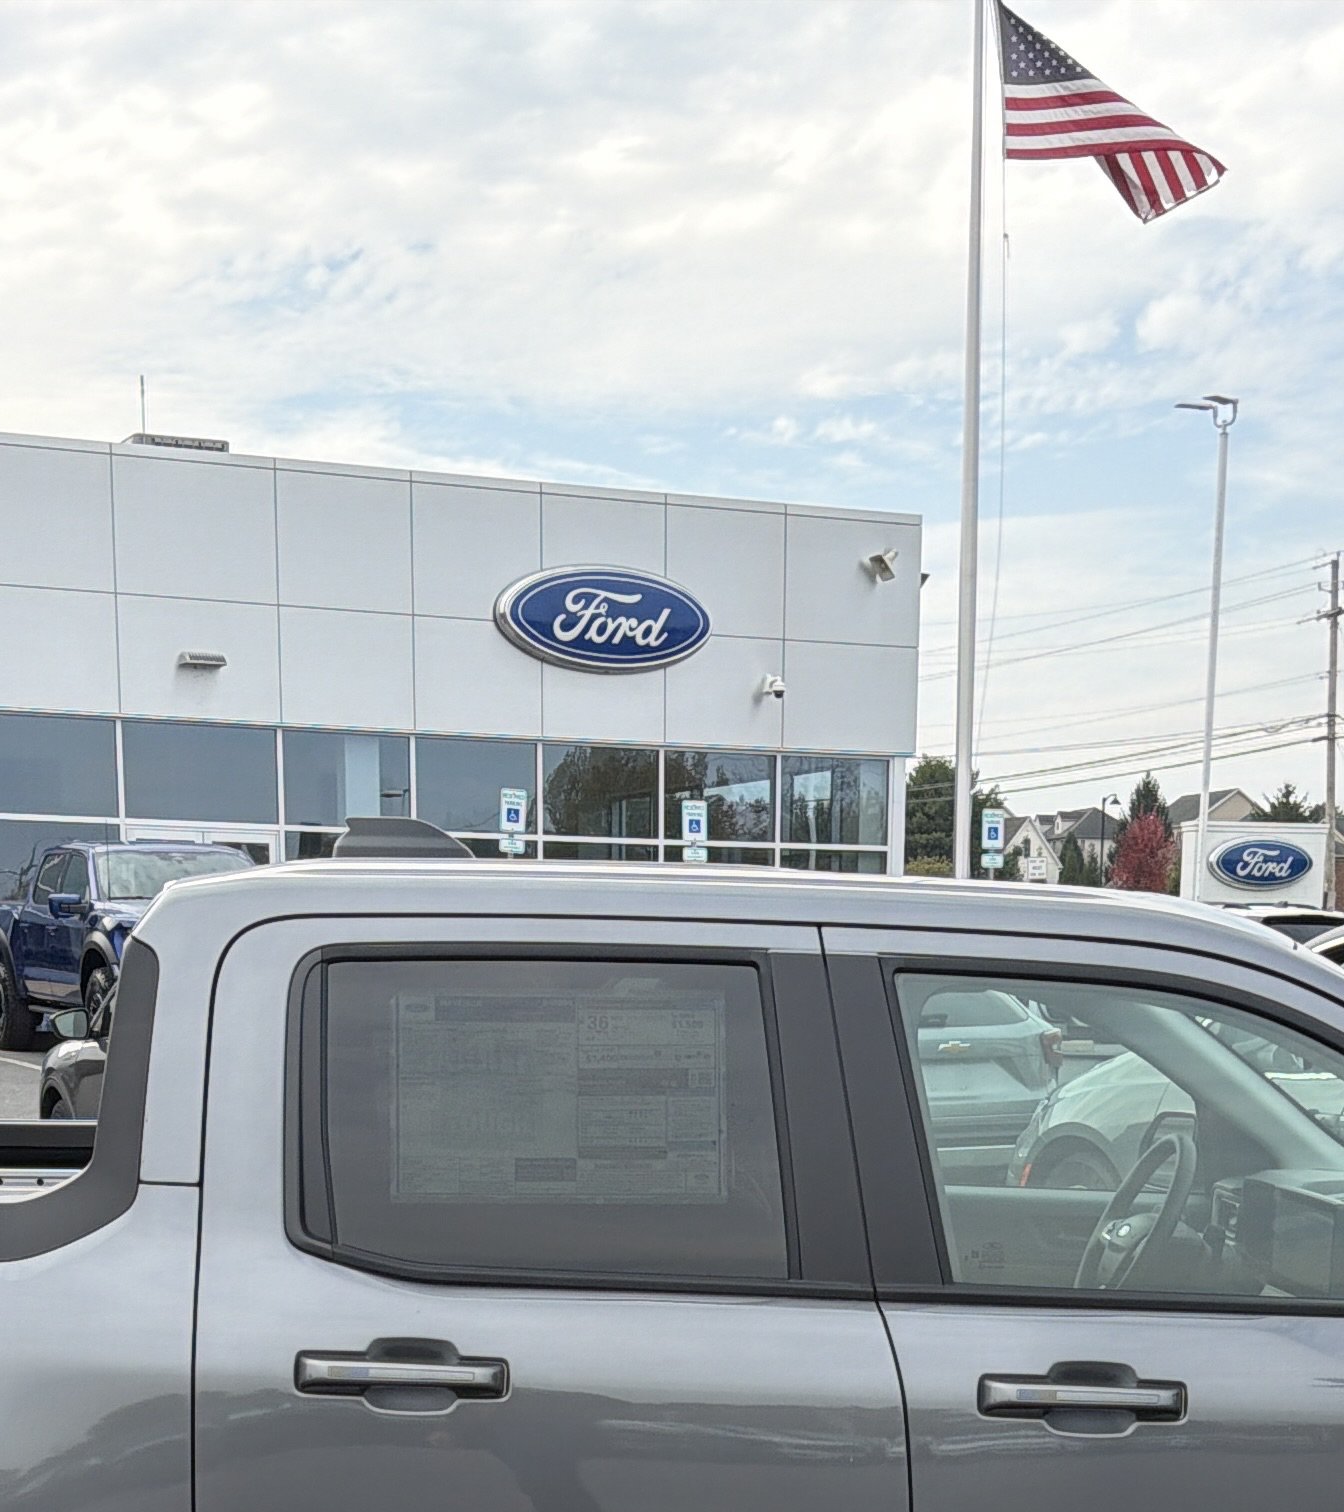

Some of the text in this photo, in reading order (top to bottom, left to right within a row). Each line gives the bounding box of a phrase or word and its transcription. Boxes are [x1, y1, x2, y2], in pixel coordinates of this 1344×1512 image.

[552, 587, 672, 647] Ford
[1236, 847, 1294, 878] Ford
[587, 1015, 609, 1030] 36
